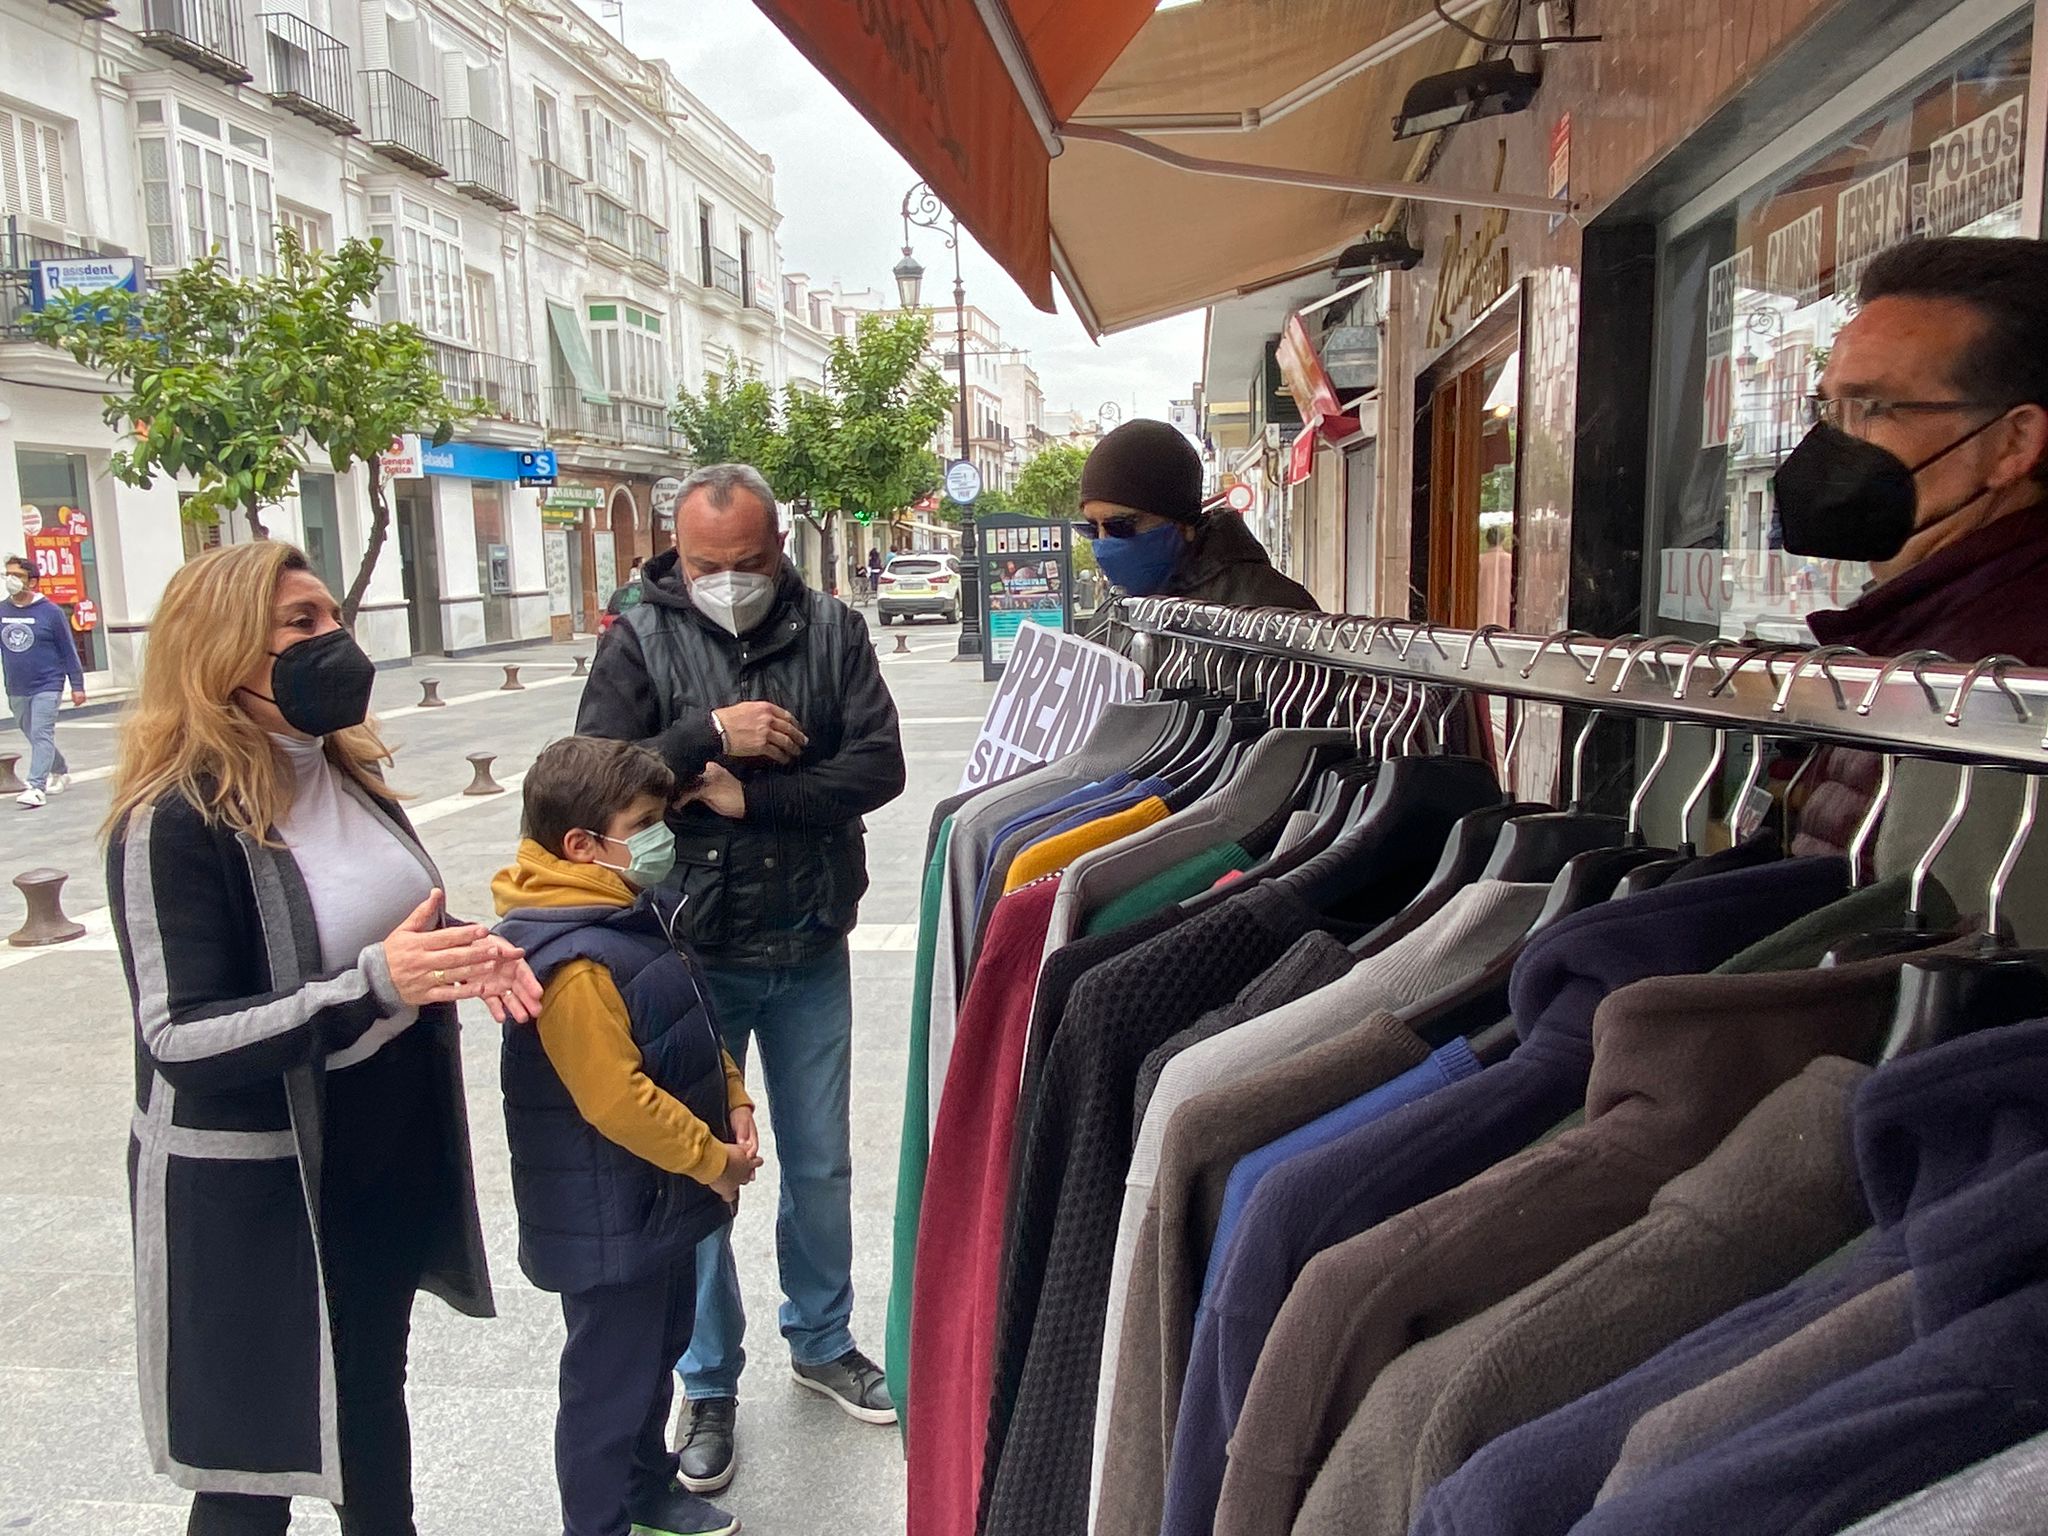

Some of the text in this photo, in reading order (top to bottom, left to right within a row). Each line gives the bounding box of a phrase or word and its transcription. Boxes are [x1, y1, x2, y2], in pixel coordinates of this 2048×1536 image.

[1931, 104, 2019, 189] POLOS
[1838, 164, 1907, 266] JERSEY'S
[62, 264, 114, 276] asisdent
[381, 457, 414, 465] General
[423, 451, 454, 469] abadell
[535, 455, 551, 475] S
[35, 549, 58, 576] 50
[985, 626, 1136, 760] PREND
